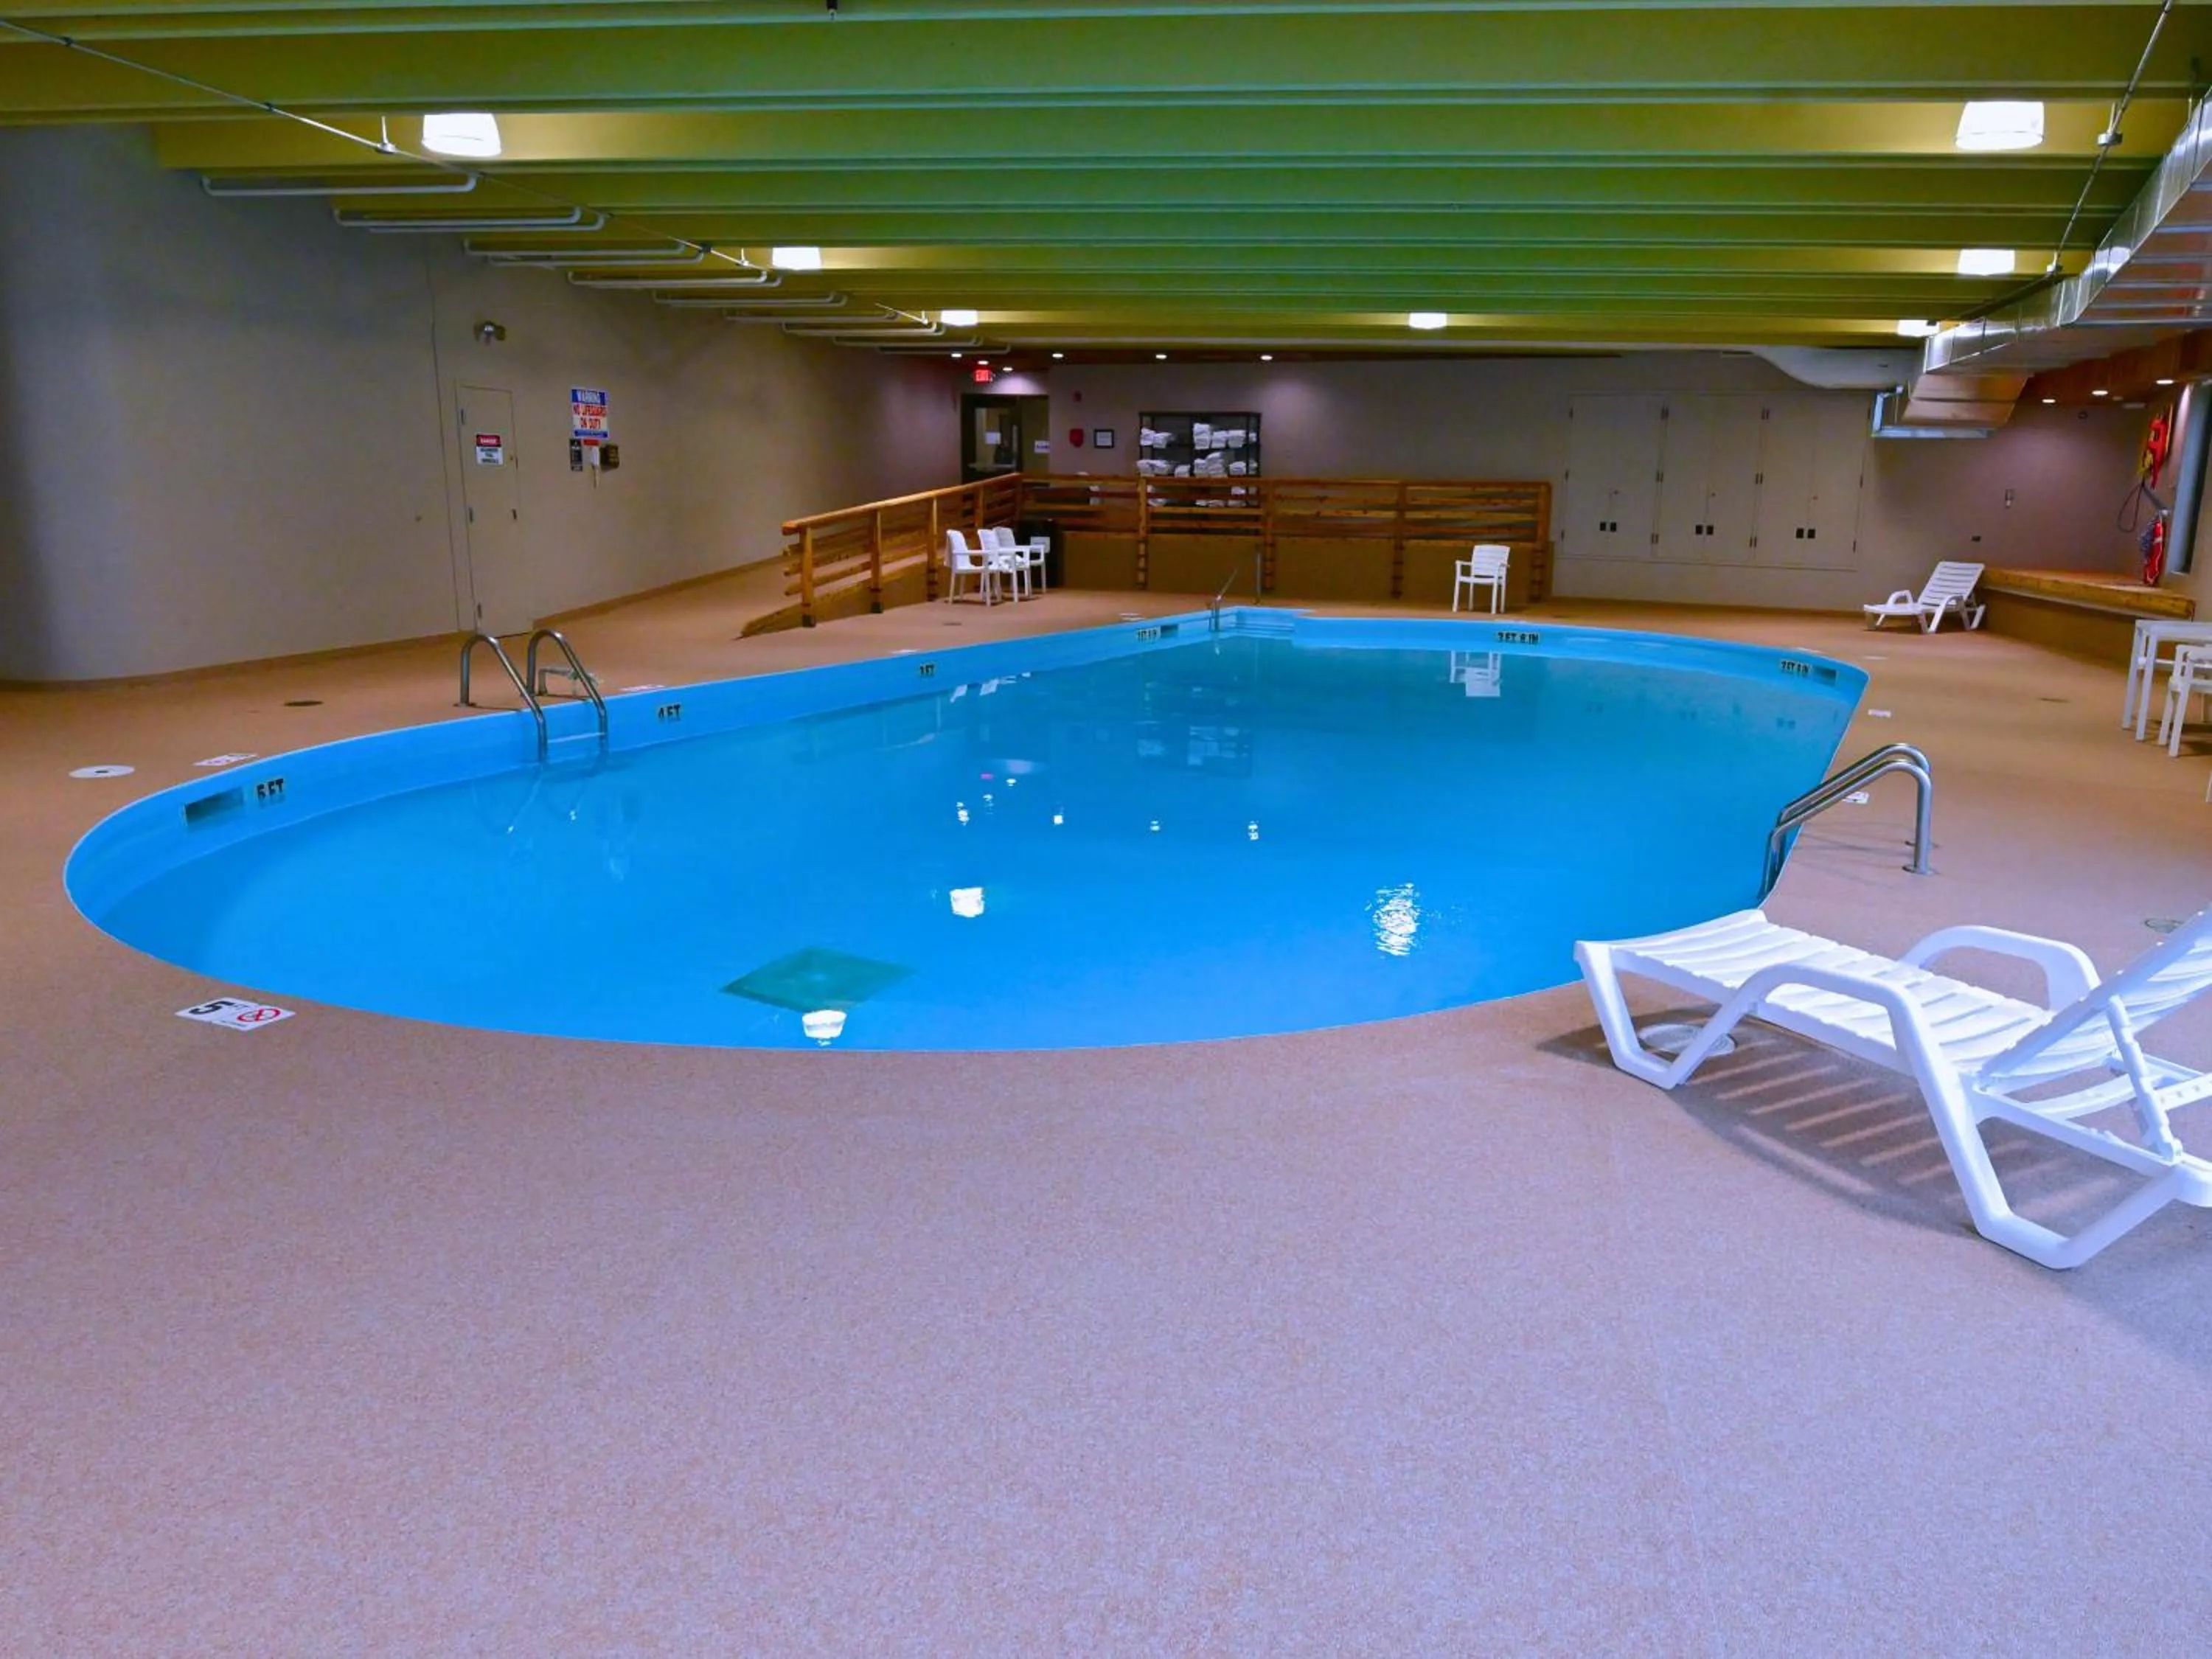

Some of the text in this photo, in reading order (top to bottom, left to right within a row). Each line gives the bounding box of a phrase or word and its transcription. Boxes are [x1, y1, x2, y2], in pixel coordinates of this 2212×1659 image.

[574, 403, 580, 415] NO
[268, 777, 284, 796] FT
[188, 1001, 235, 1015] 5
